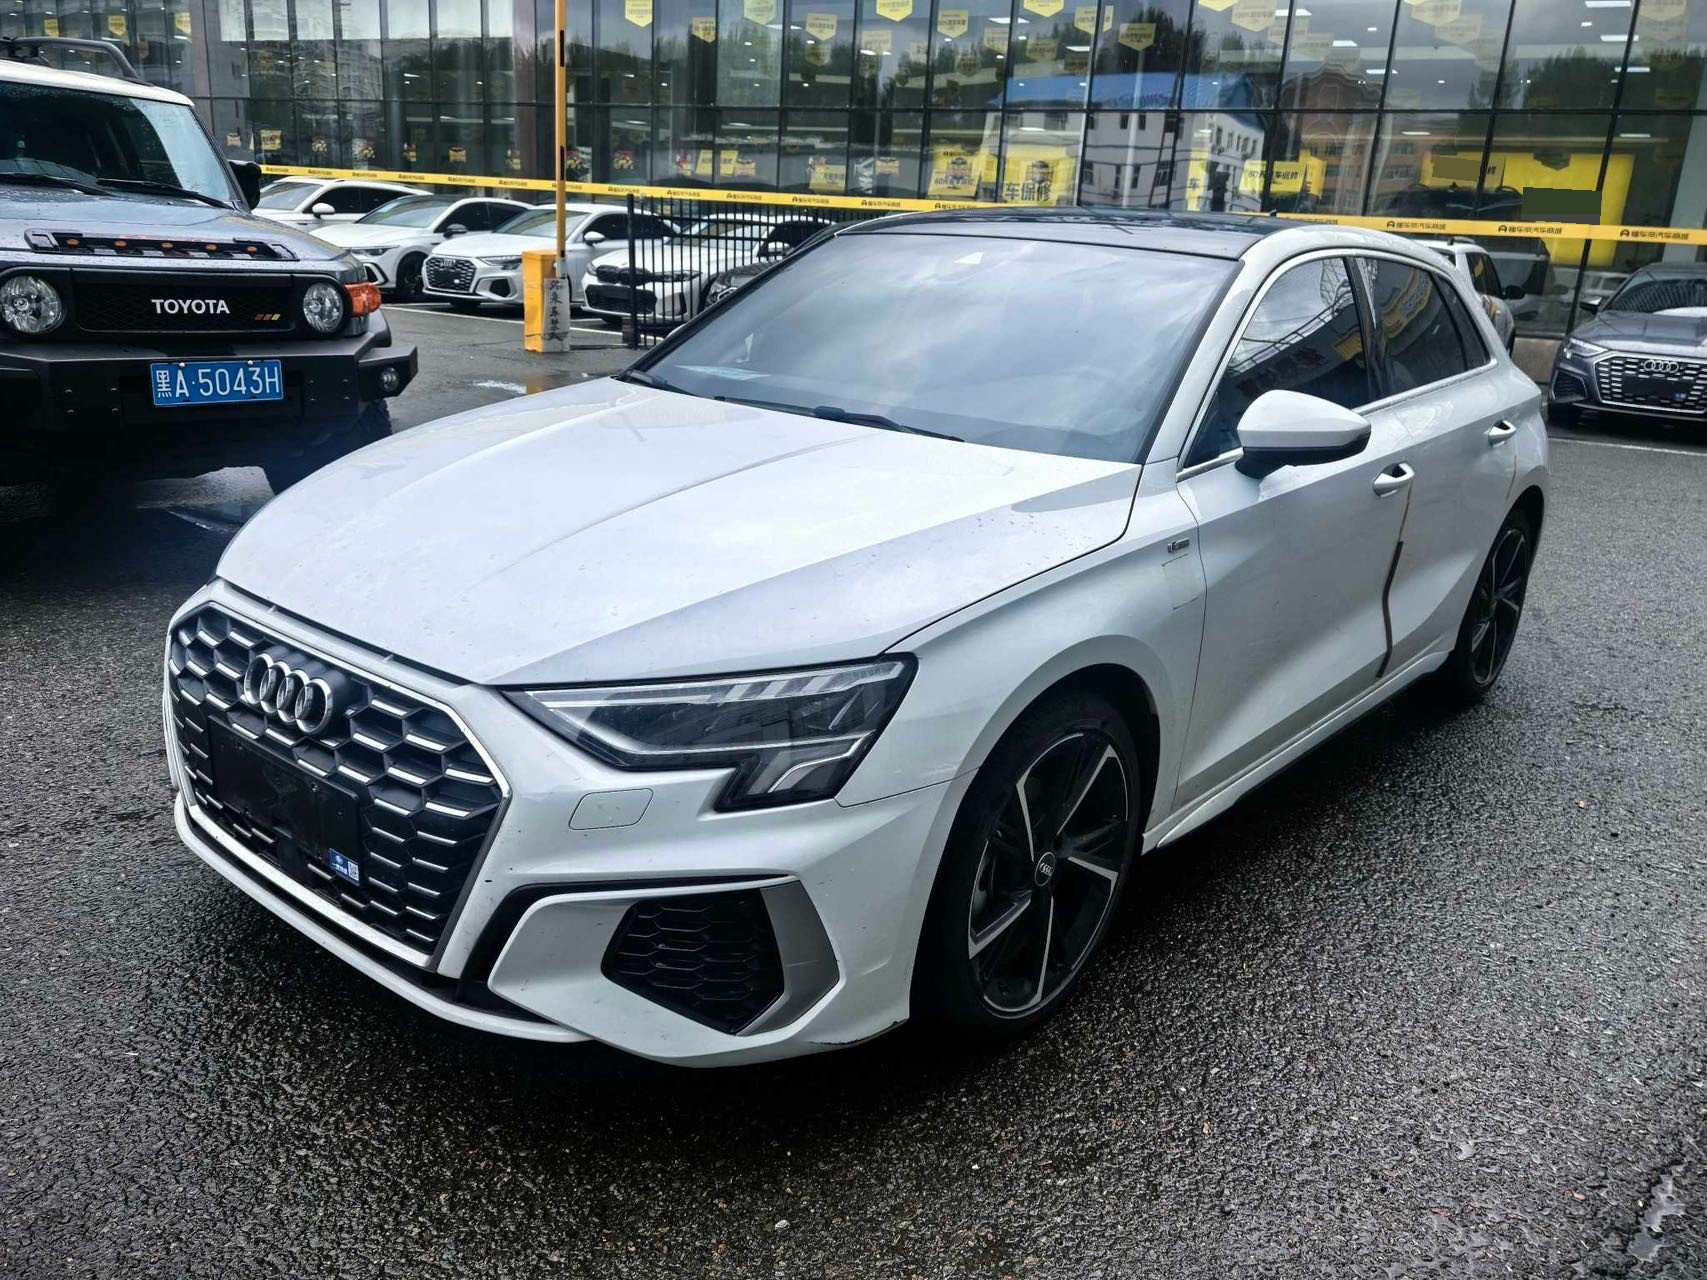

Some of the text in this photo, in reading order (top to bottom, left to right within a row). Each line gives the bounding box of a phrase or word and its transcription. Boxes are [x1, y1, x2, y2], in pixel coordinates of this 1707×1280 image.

[1004, 181, 1052, 202] 车保修
[151, 299, 230, 315] TOYOTA
